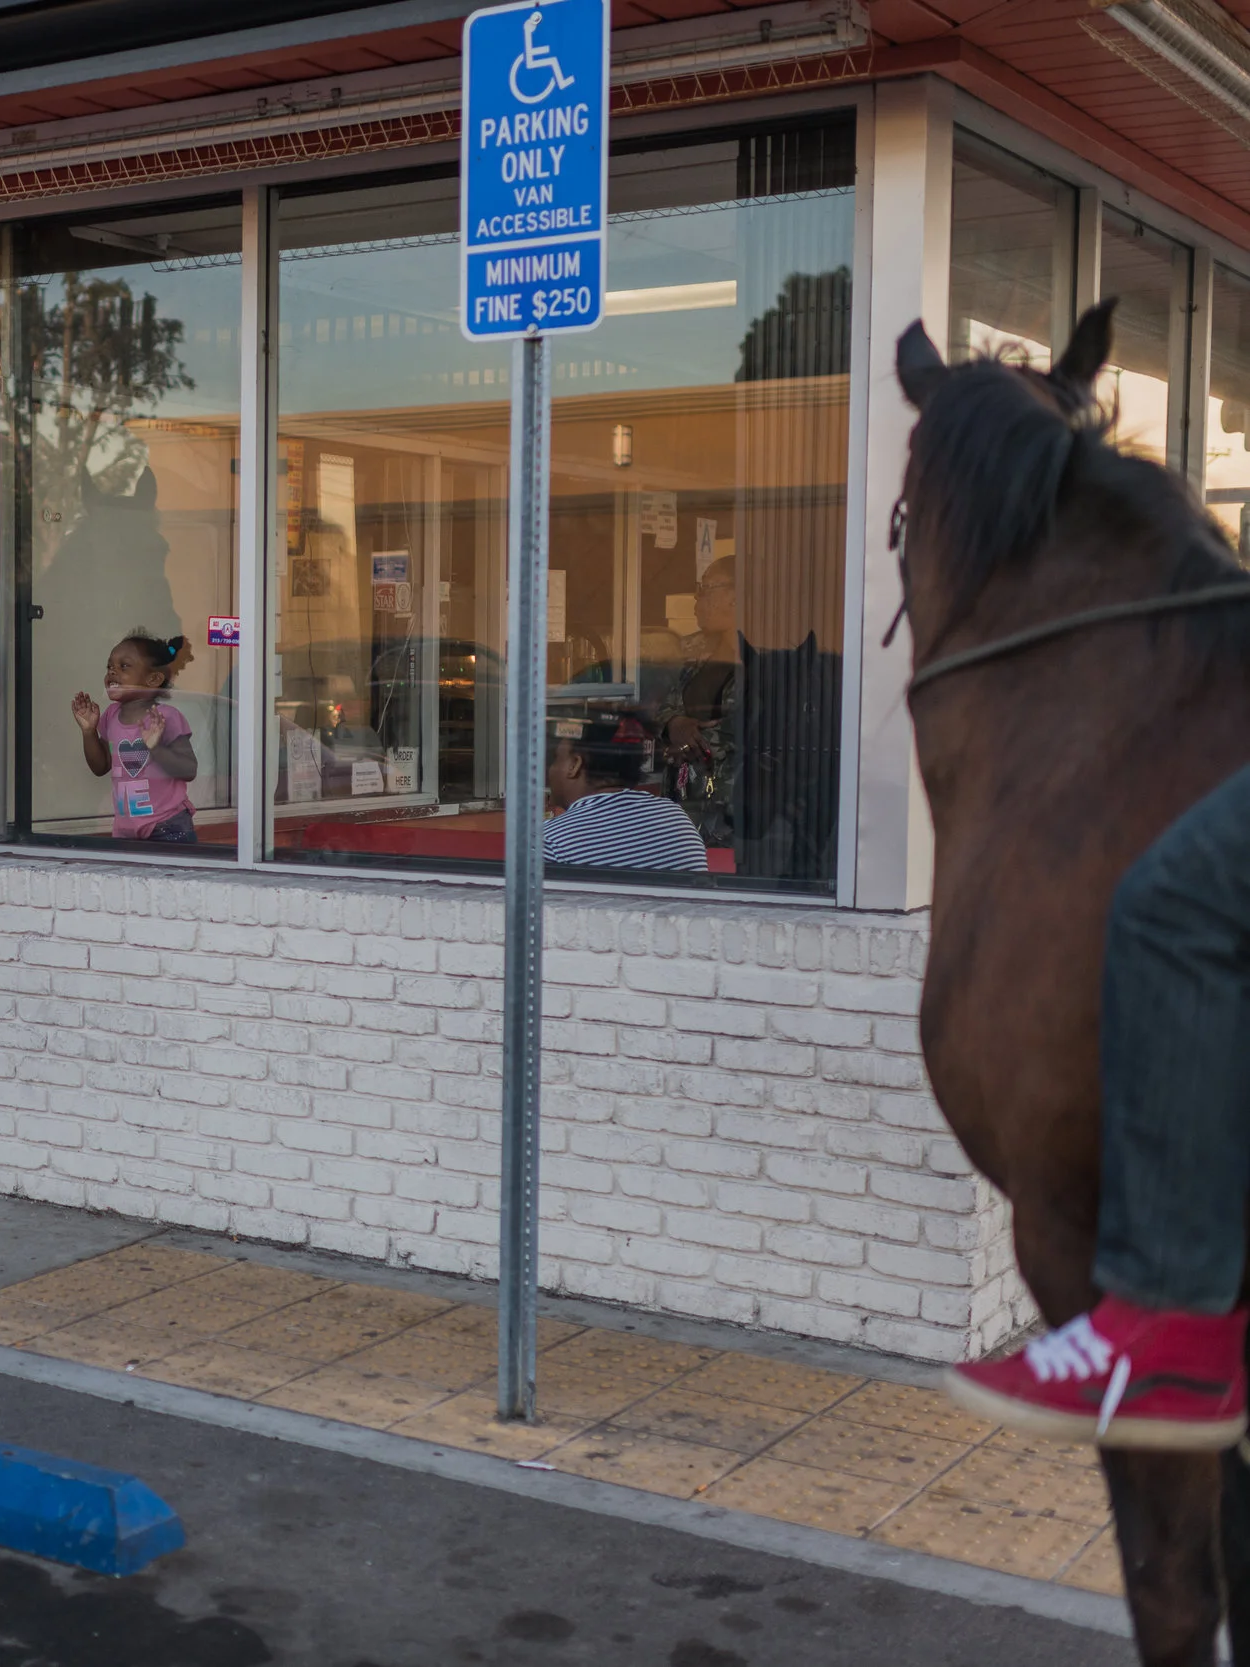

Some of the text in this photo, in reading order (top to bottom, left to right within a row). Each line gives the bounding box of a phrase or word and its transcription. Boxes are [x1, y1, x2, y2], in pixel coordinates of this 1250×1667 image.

[480, 103, 589, 149] PARKING
[501, 145, 566, 183] ONLY
[513, 184, 553, 207] VAN
[476, 205, 592, 238] ACCESSIBLE
[485, 250, 581, 287] MINIMUM
[474, 286, 591, 324] FINE $250
[375, 595, 394, 608] STAR
[393, 750, 413, 761] ORDER
[395, 775, 411, 786] HERE
